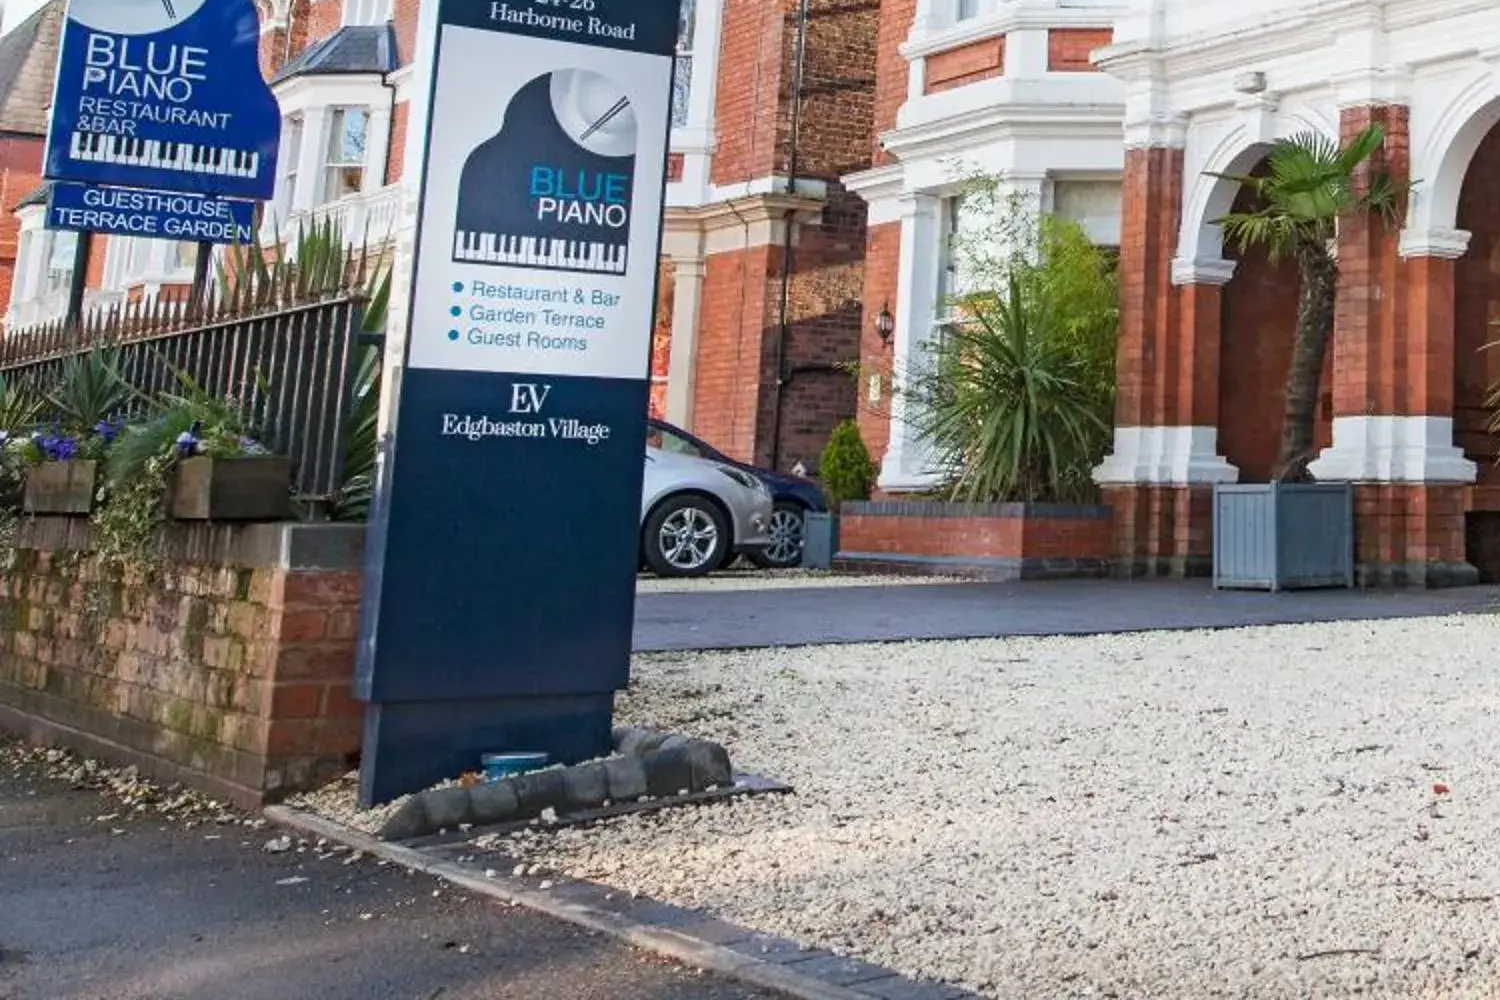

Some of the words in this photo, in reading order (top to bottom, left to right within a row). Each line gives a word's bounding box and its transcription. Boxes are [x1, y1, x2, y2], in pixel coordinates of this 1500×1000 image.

[489, 1, 583, 33] Harborne
[587, 15, 636, 41] Road
[86, 33, 209, 81] BLUE
[82, 67, 193, 104] PIANO
[79, 96, 232, 131] RESTAURANT
[530, 166, 628, 202] BLUE
[83, 188, 230, 219] GUESTHOUSE
[536, 198, 627, 227] PIANO
[55, 207, 157, 233] TERRACE
[164, 217, 251, 240] GARDEN
[471, 281, 569, 304] Restaurant
[574, 287, 586, 304] &
[591, 289, 620, 307] Bar
[469, 305, 536, 325] Garden
[543, 310, 605, 329] Terrace
[467, 329, 522, 348] Guest
[527, 332, 588, 351] Rooms
[508, 383, 552, 414] EV
[441, 414, 545, 441] Edgbaston
[549, 418, 610, 445] Village
